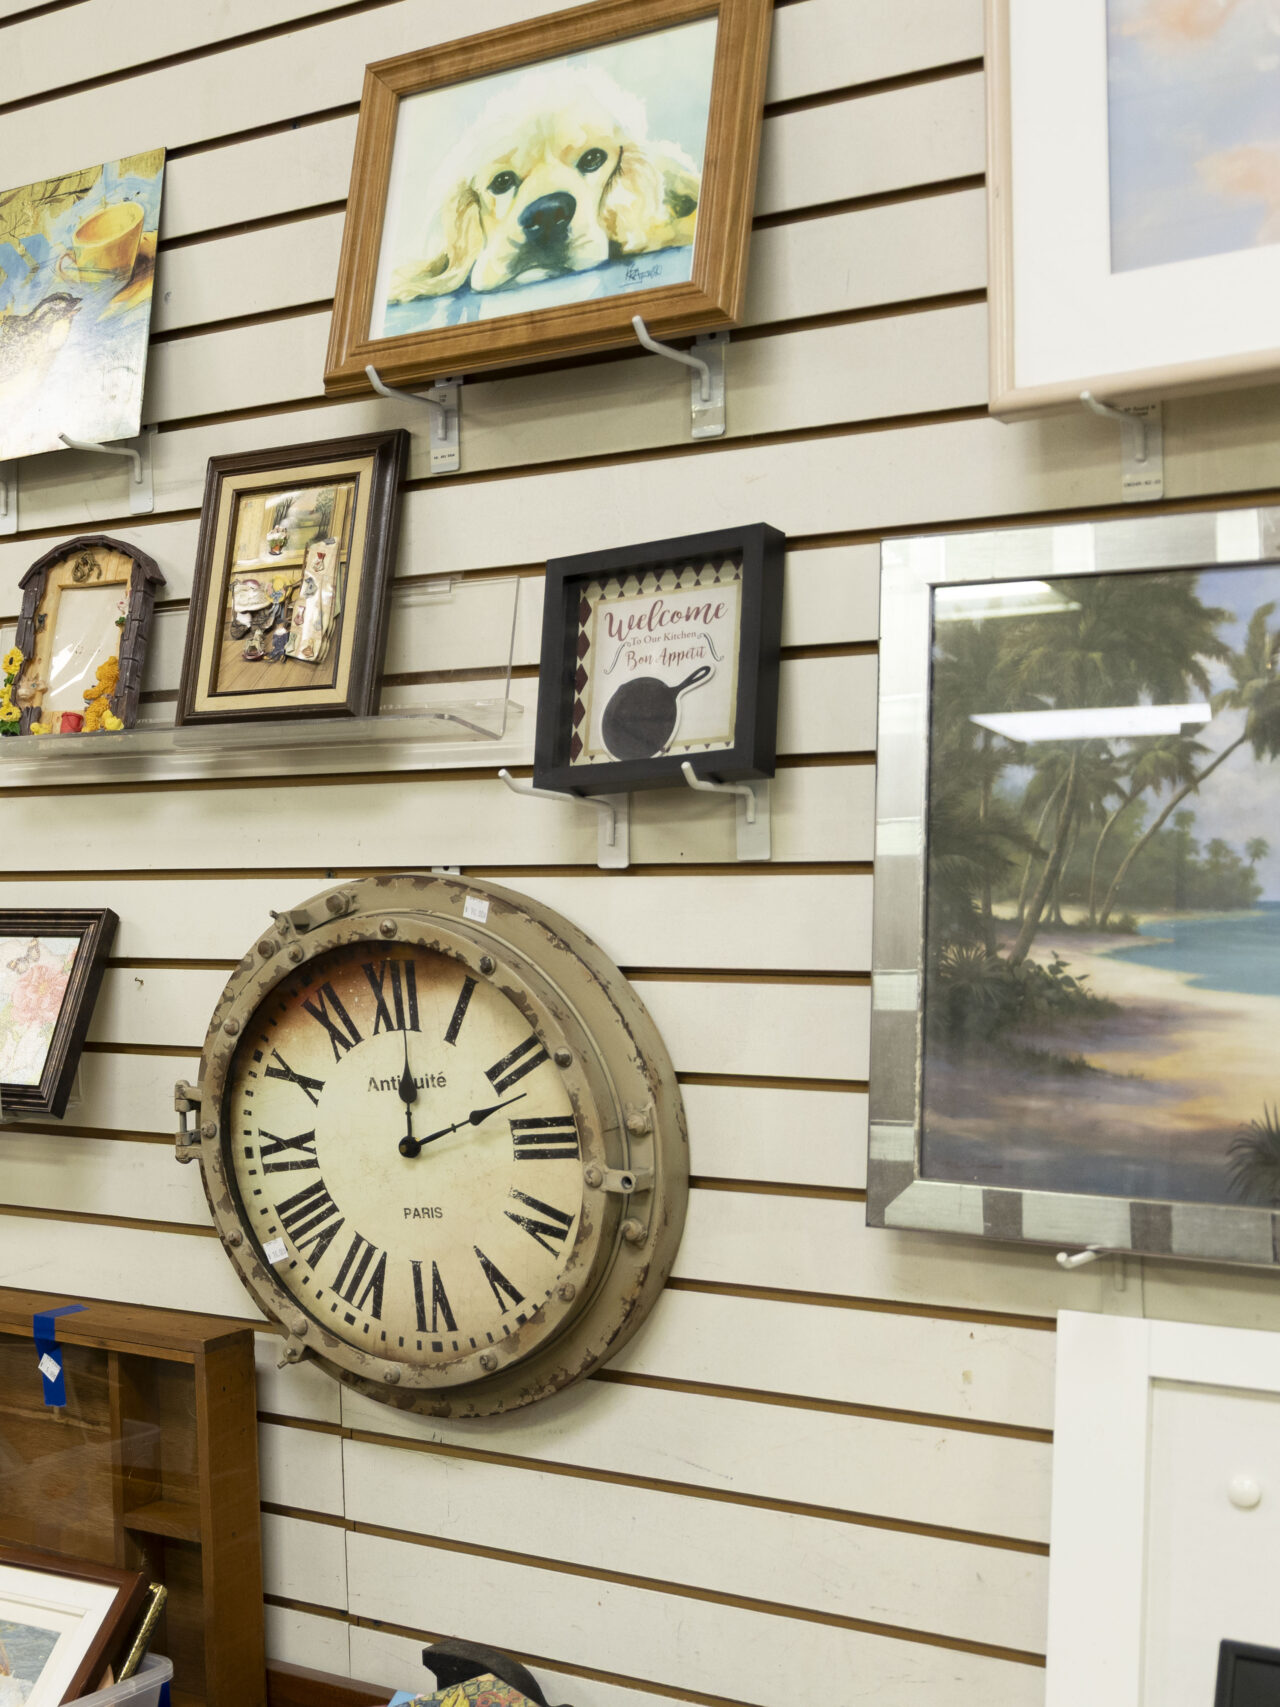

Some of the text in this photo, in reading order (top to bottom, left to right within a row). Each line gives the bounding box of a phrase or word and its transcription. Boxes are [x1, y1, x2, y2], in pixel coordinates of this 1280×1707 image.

[604, 599, 729, 642] Welcome
[631, 630, 697, 647] To Our Kitchen
[625, 646, 706, 671] Bon Appetit
[301, 981, 365, 1064] XI
[361, 959, 421, 1036] XII
[443, 975, 479, 1047] I
[264, 1047, 326, 1108] X
[367, 1071, 447, 1093] Antiuité
[484, 1032, 552, 1097] II
[258, 1128, 320, 1176] IX
[508, 1114, 581, 1162] III
[273, 1176, 345, 1271] VIII
[404, 1207, 444, 1220] PARIS
[504, 1186, 576, 1260] IV
[329, 1230, 387, 1321] VII
[409, 1260, 459, 1333] VI
[473, 1244, 526, 1316] V
